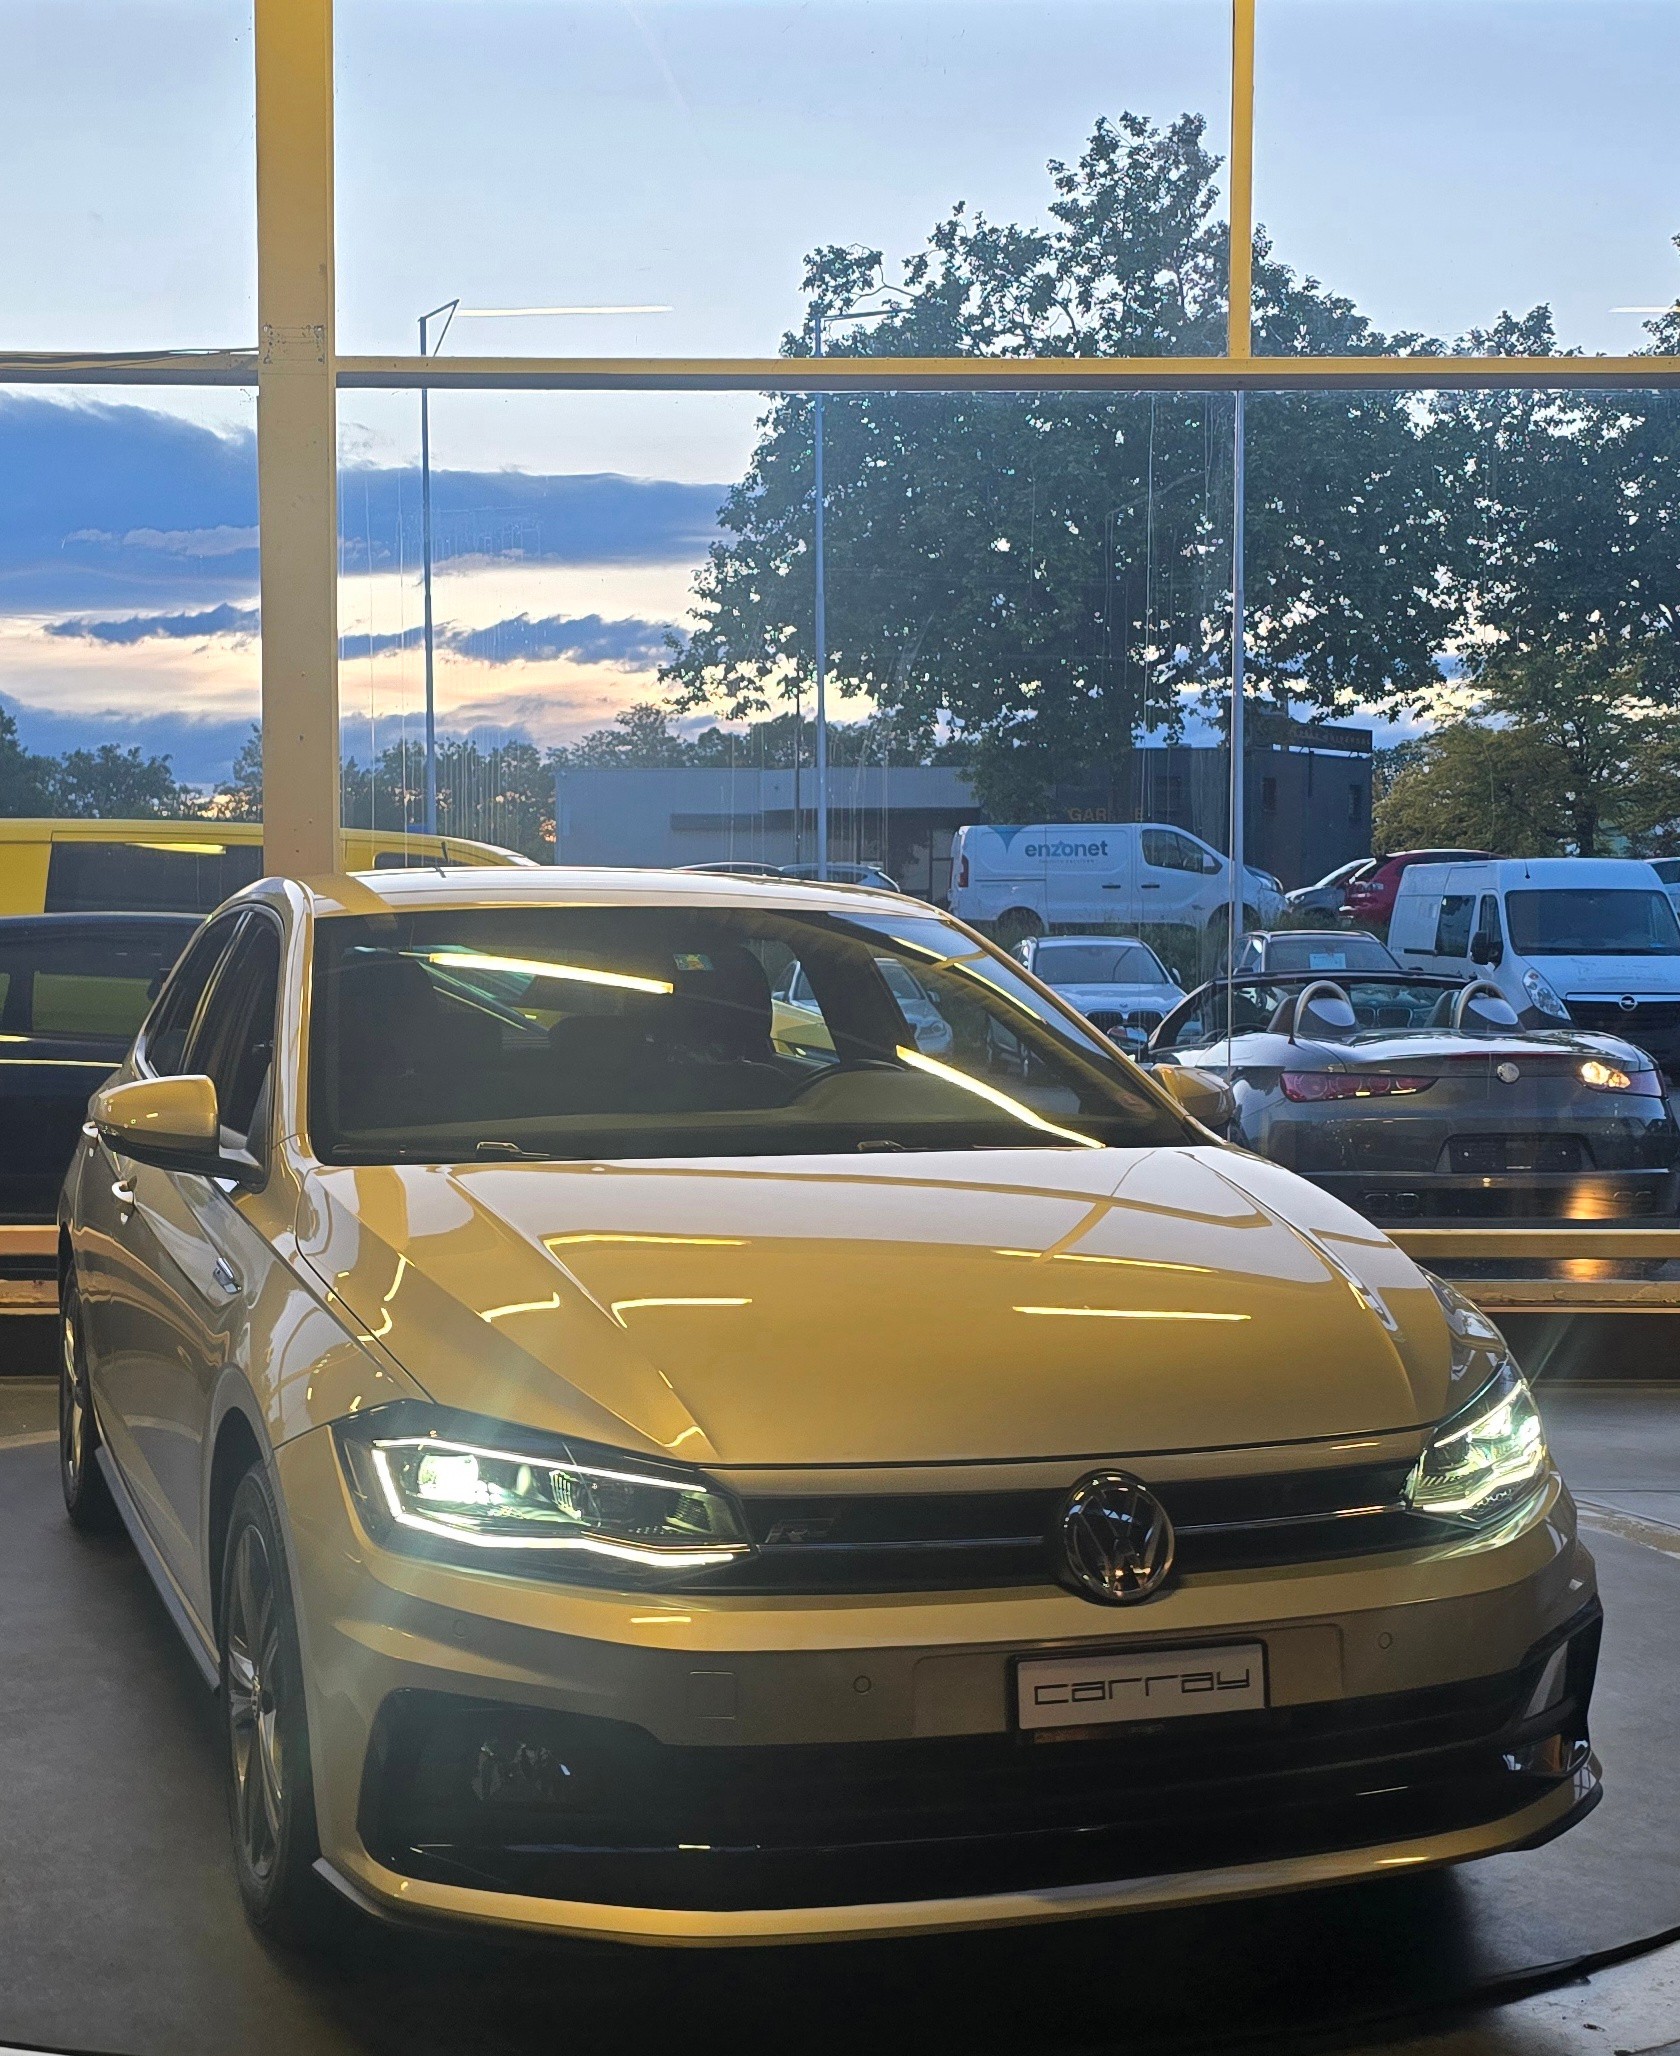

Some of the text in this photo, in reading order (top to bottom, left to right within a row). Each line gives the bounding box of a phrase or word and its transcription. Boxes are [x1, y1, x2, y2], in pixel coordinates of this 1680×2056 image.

[1069, 807, 1144, 821] GARE
[1024, 840, 1108, 857] enzonet
[1033, 1668, 1250, 1706] carray
